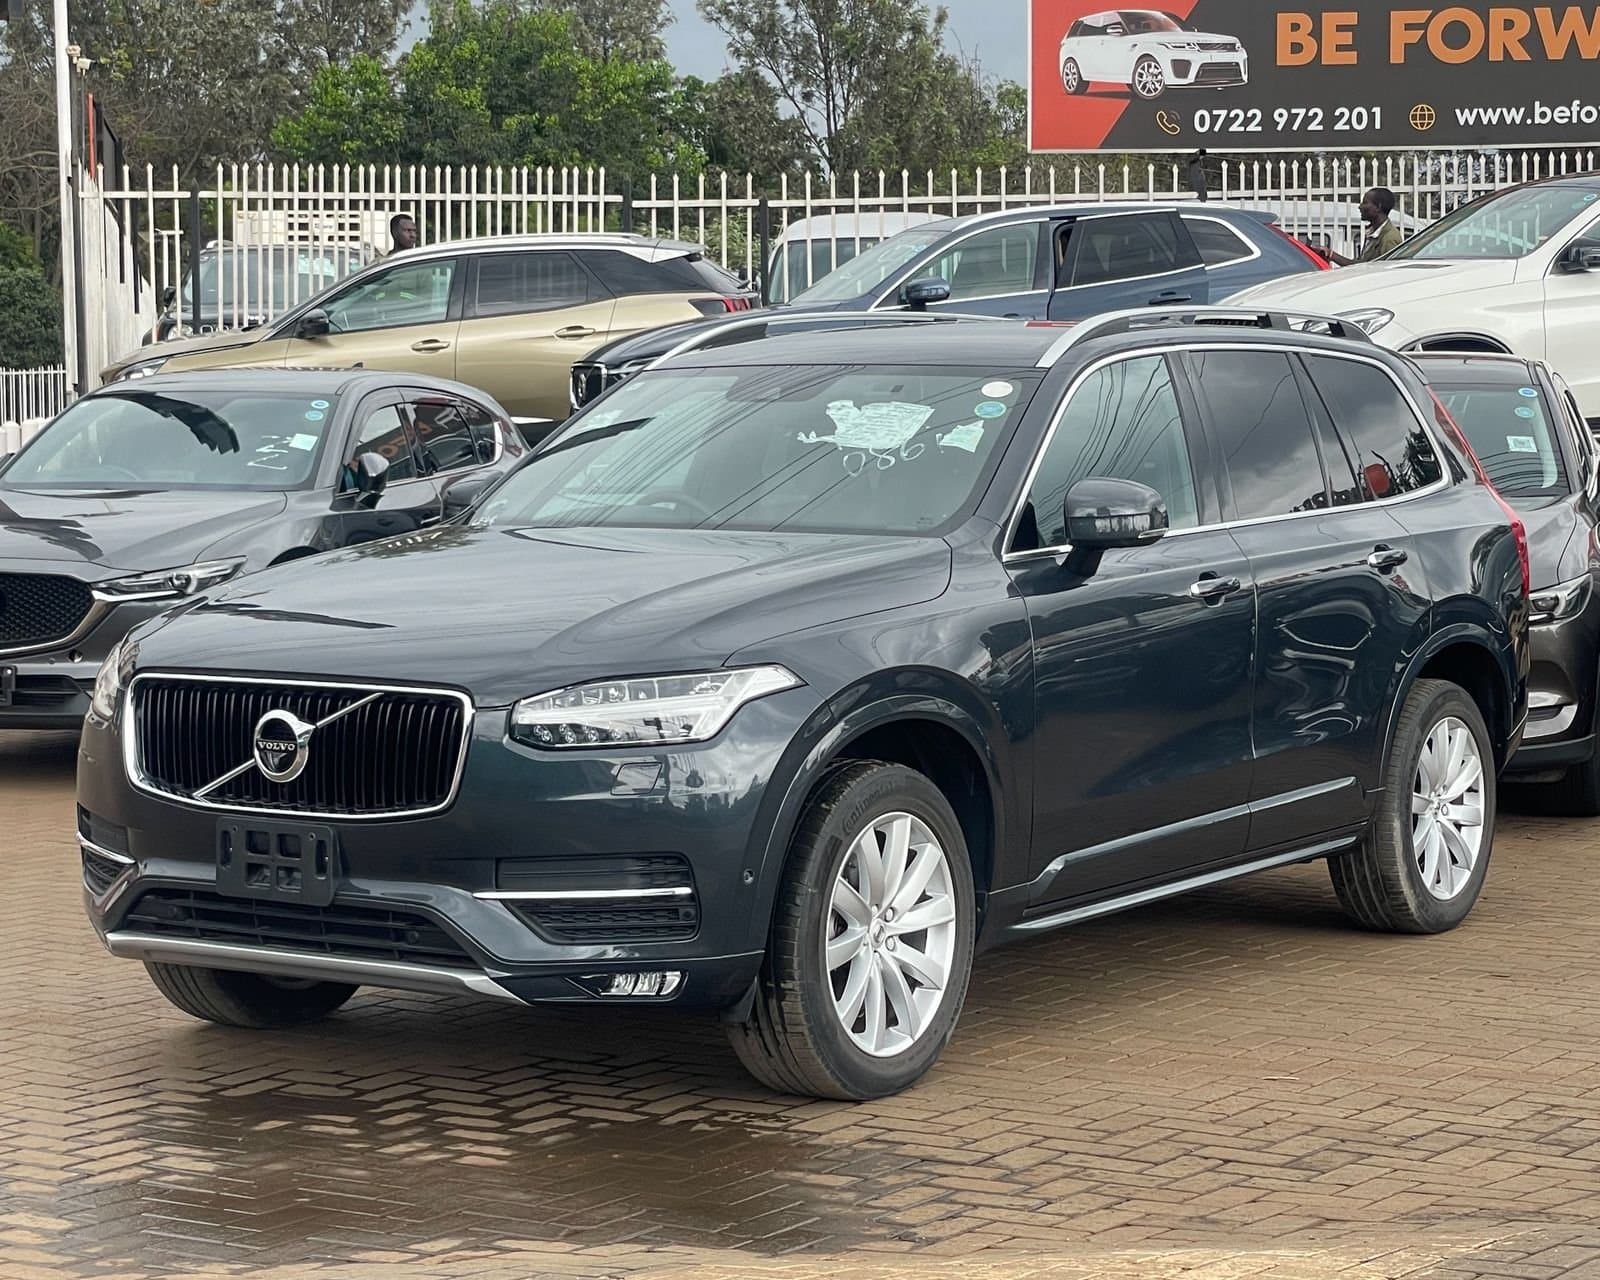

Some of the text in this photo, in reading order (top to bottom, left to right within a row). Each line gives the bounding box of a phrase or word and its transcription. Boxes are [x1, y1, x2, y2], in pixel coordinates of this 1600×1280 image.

[1276, 6, 1600, 66] BE FORW
[1193, 106, 1382, 133] 0722 972 201
[1455, 99, 1600, 126] www.befo
[257, 741, 296, 751] VOLVO
